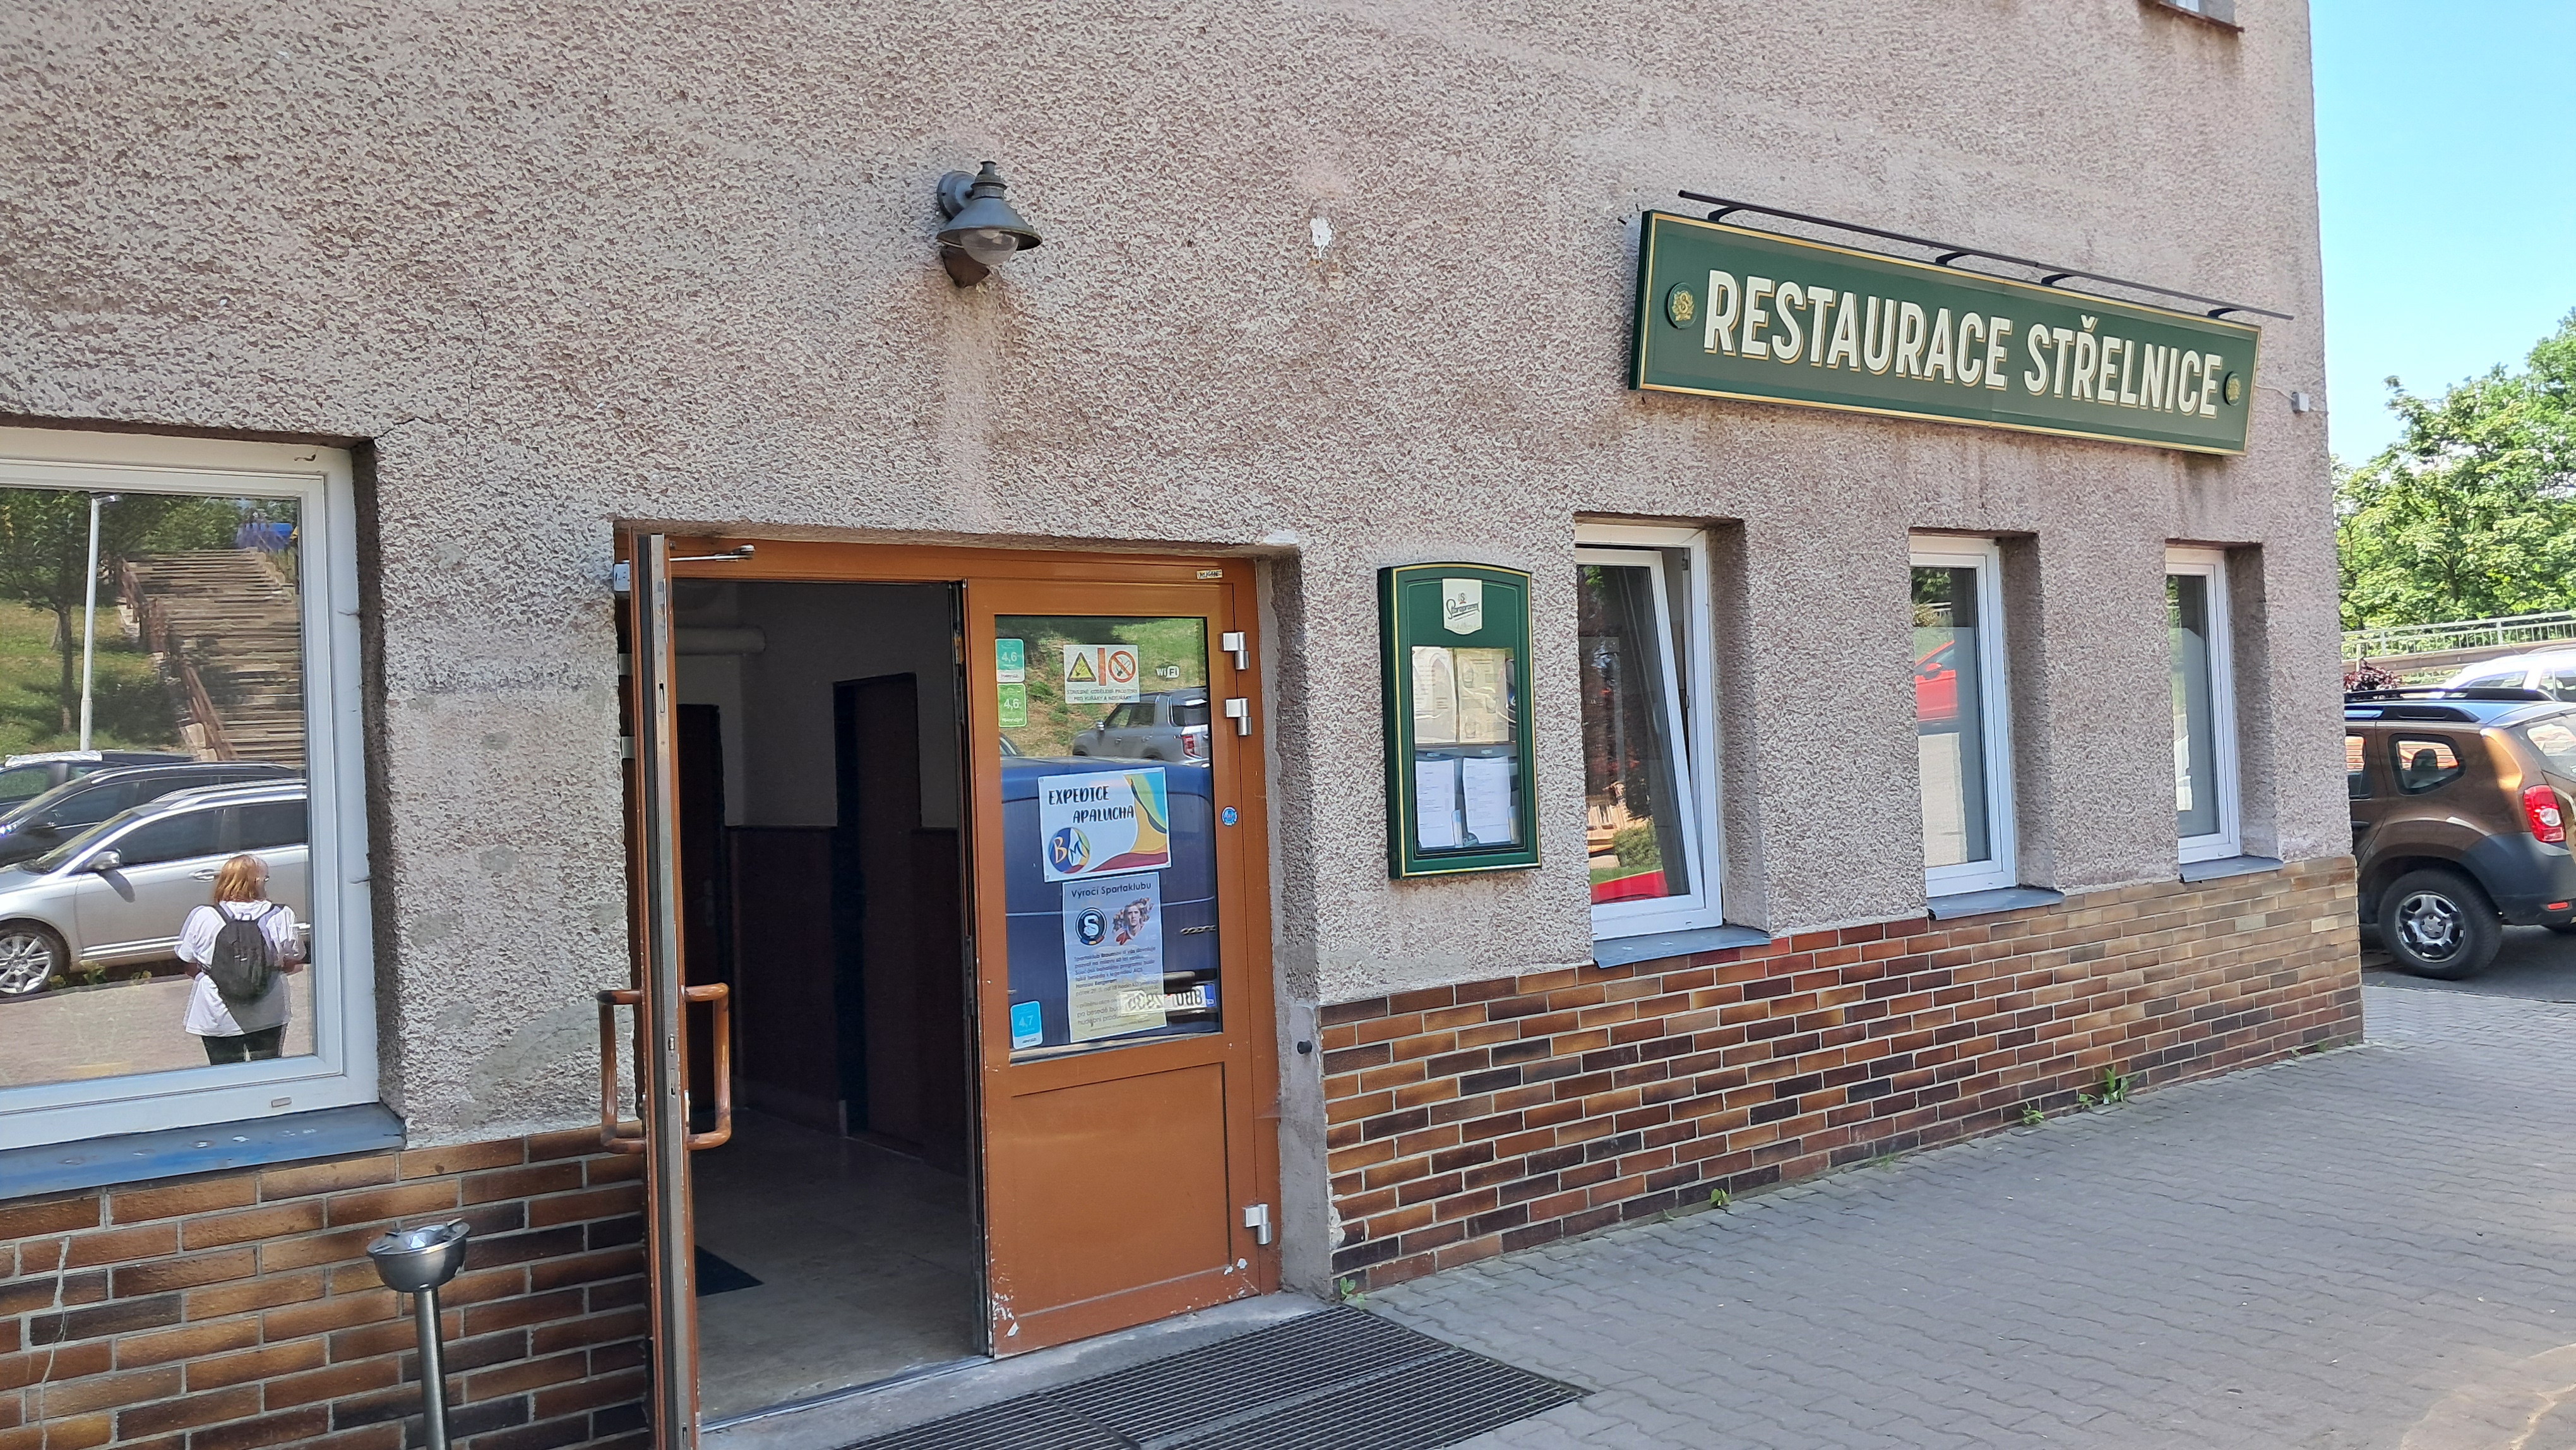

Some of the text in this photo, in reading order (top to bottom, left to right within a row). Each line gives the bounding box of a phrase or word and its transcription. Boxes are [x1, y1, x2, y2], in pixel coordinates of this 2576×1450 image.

[1703, 269, 2224, 417] RESTAURACE STŘELNICE
[1001, 651, 1018, 663] 4,6
[1003, 698, 1020, 710] 4,6
[1048, 786, 1109, 805] EXPEDICE
[1073, 805, 1134, 824] APALUCHA
[1071, 882, 1151, 899] Výročí Spartaklubu
